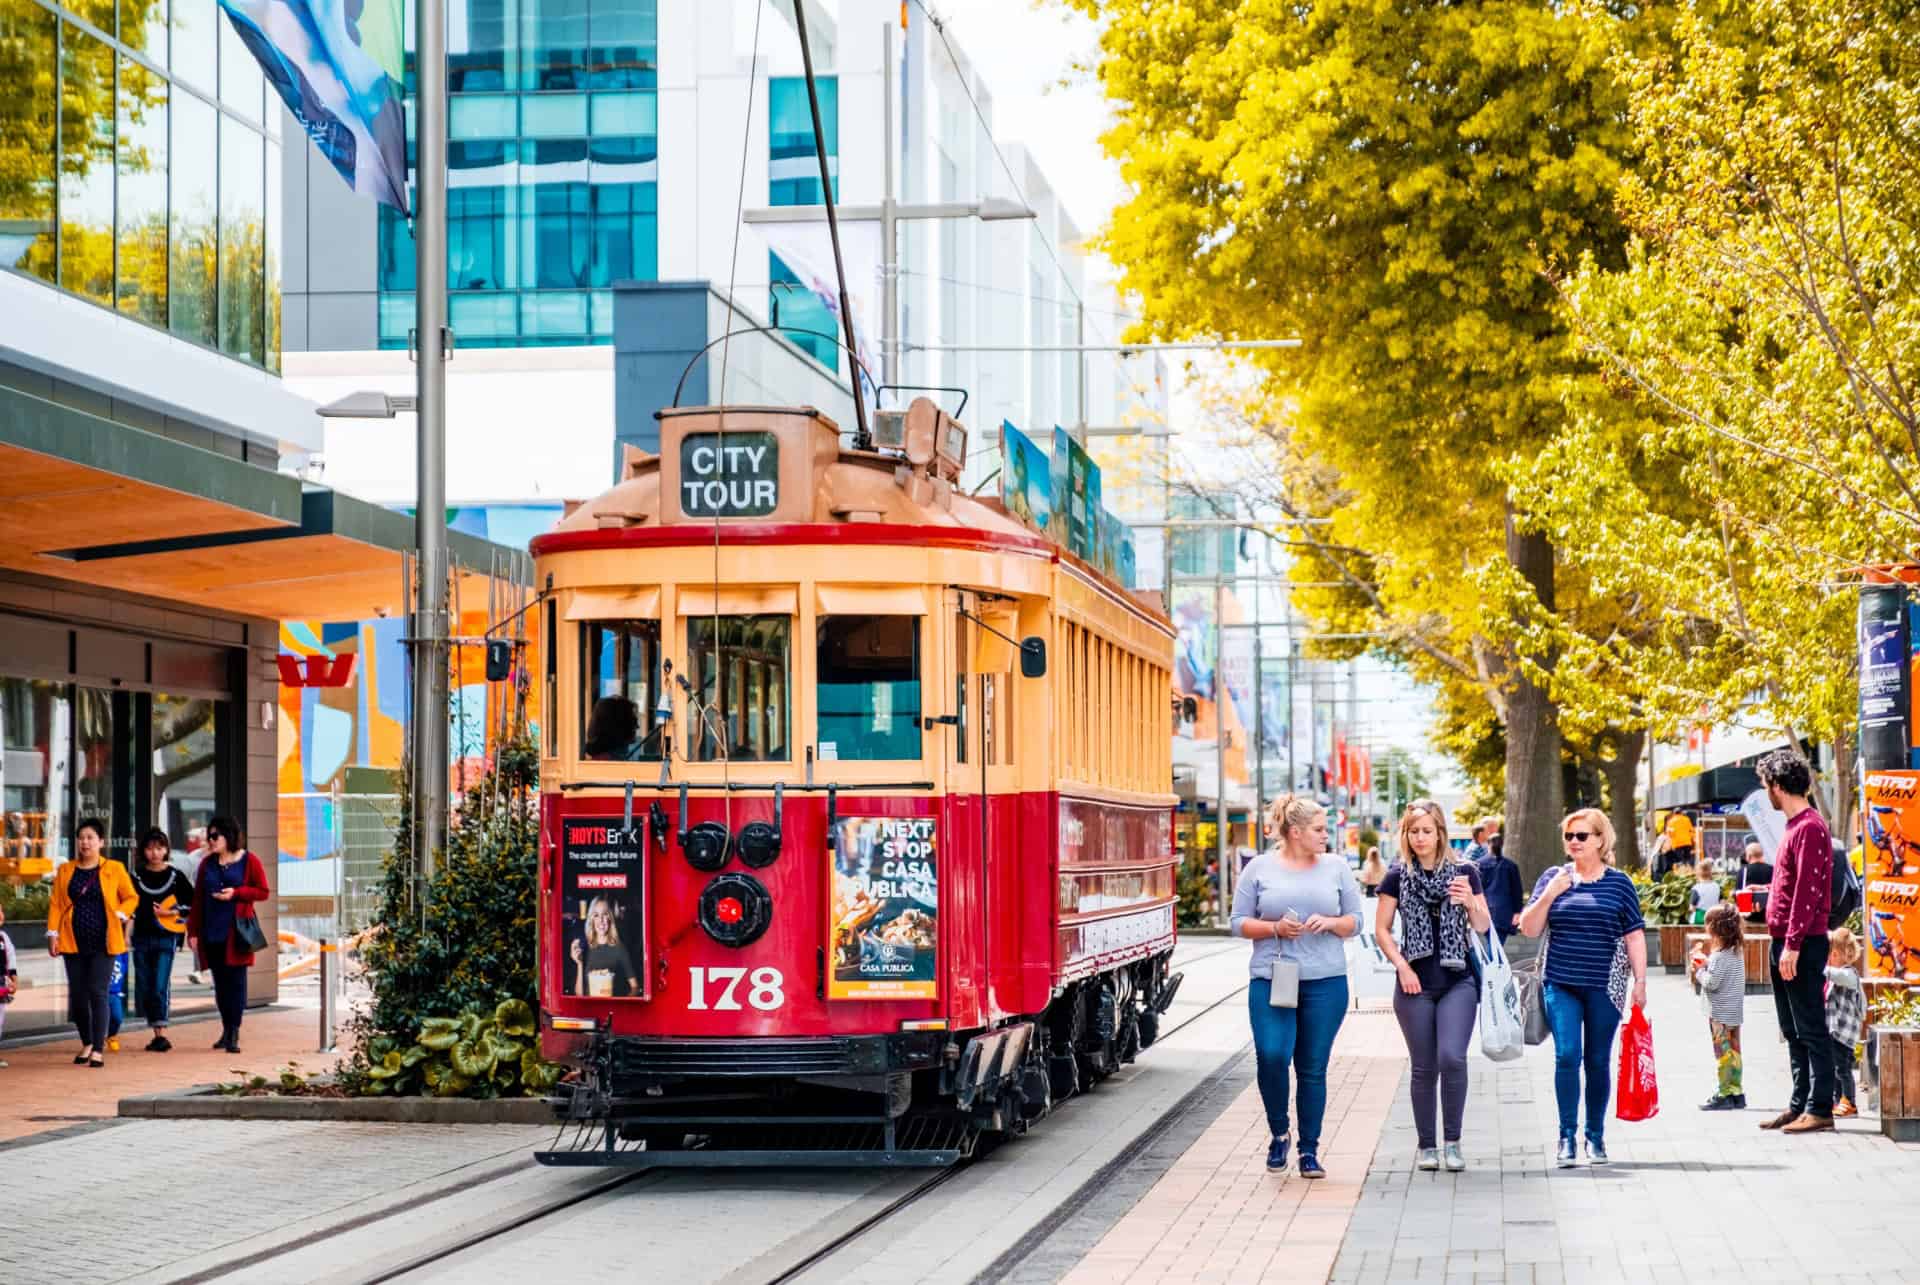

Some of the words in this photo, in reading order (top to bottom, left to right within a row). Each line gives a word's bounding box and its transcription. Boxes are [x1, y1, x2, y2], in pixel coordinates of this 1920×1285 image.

[692, 446, 767, 474] CITY
[683, 480, 776, 509] TOUR
[1878, 787, 1918, 800] MAN
[570, 826, 606, 845] HOYTS
[882, 822, 933, 839] NEXT
[882, 841, 933, 858] STOP
[881, 860, 933, 879] CASA
[578, 876, 600, 887] NOW
[602, 876, 627, 887] OPEN
[1880, 894, 1919, 907] MAN
[860, 964, 880, 973] CASA
[882, 963, 914, 973] PUBLICA
[687, 967, 785, 1010] 178
